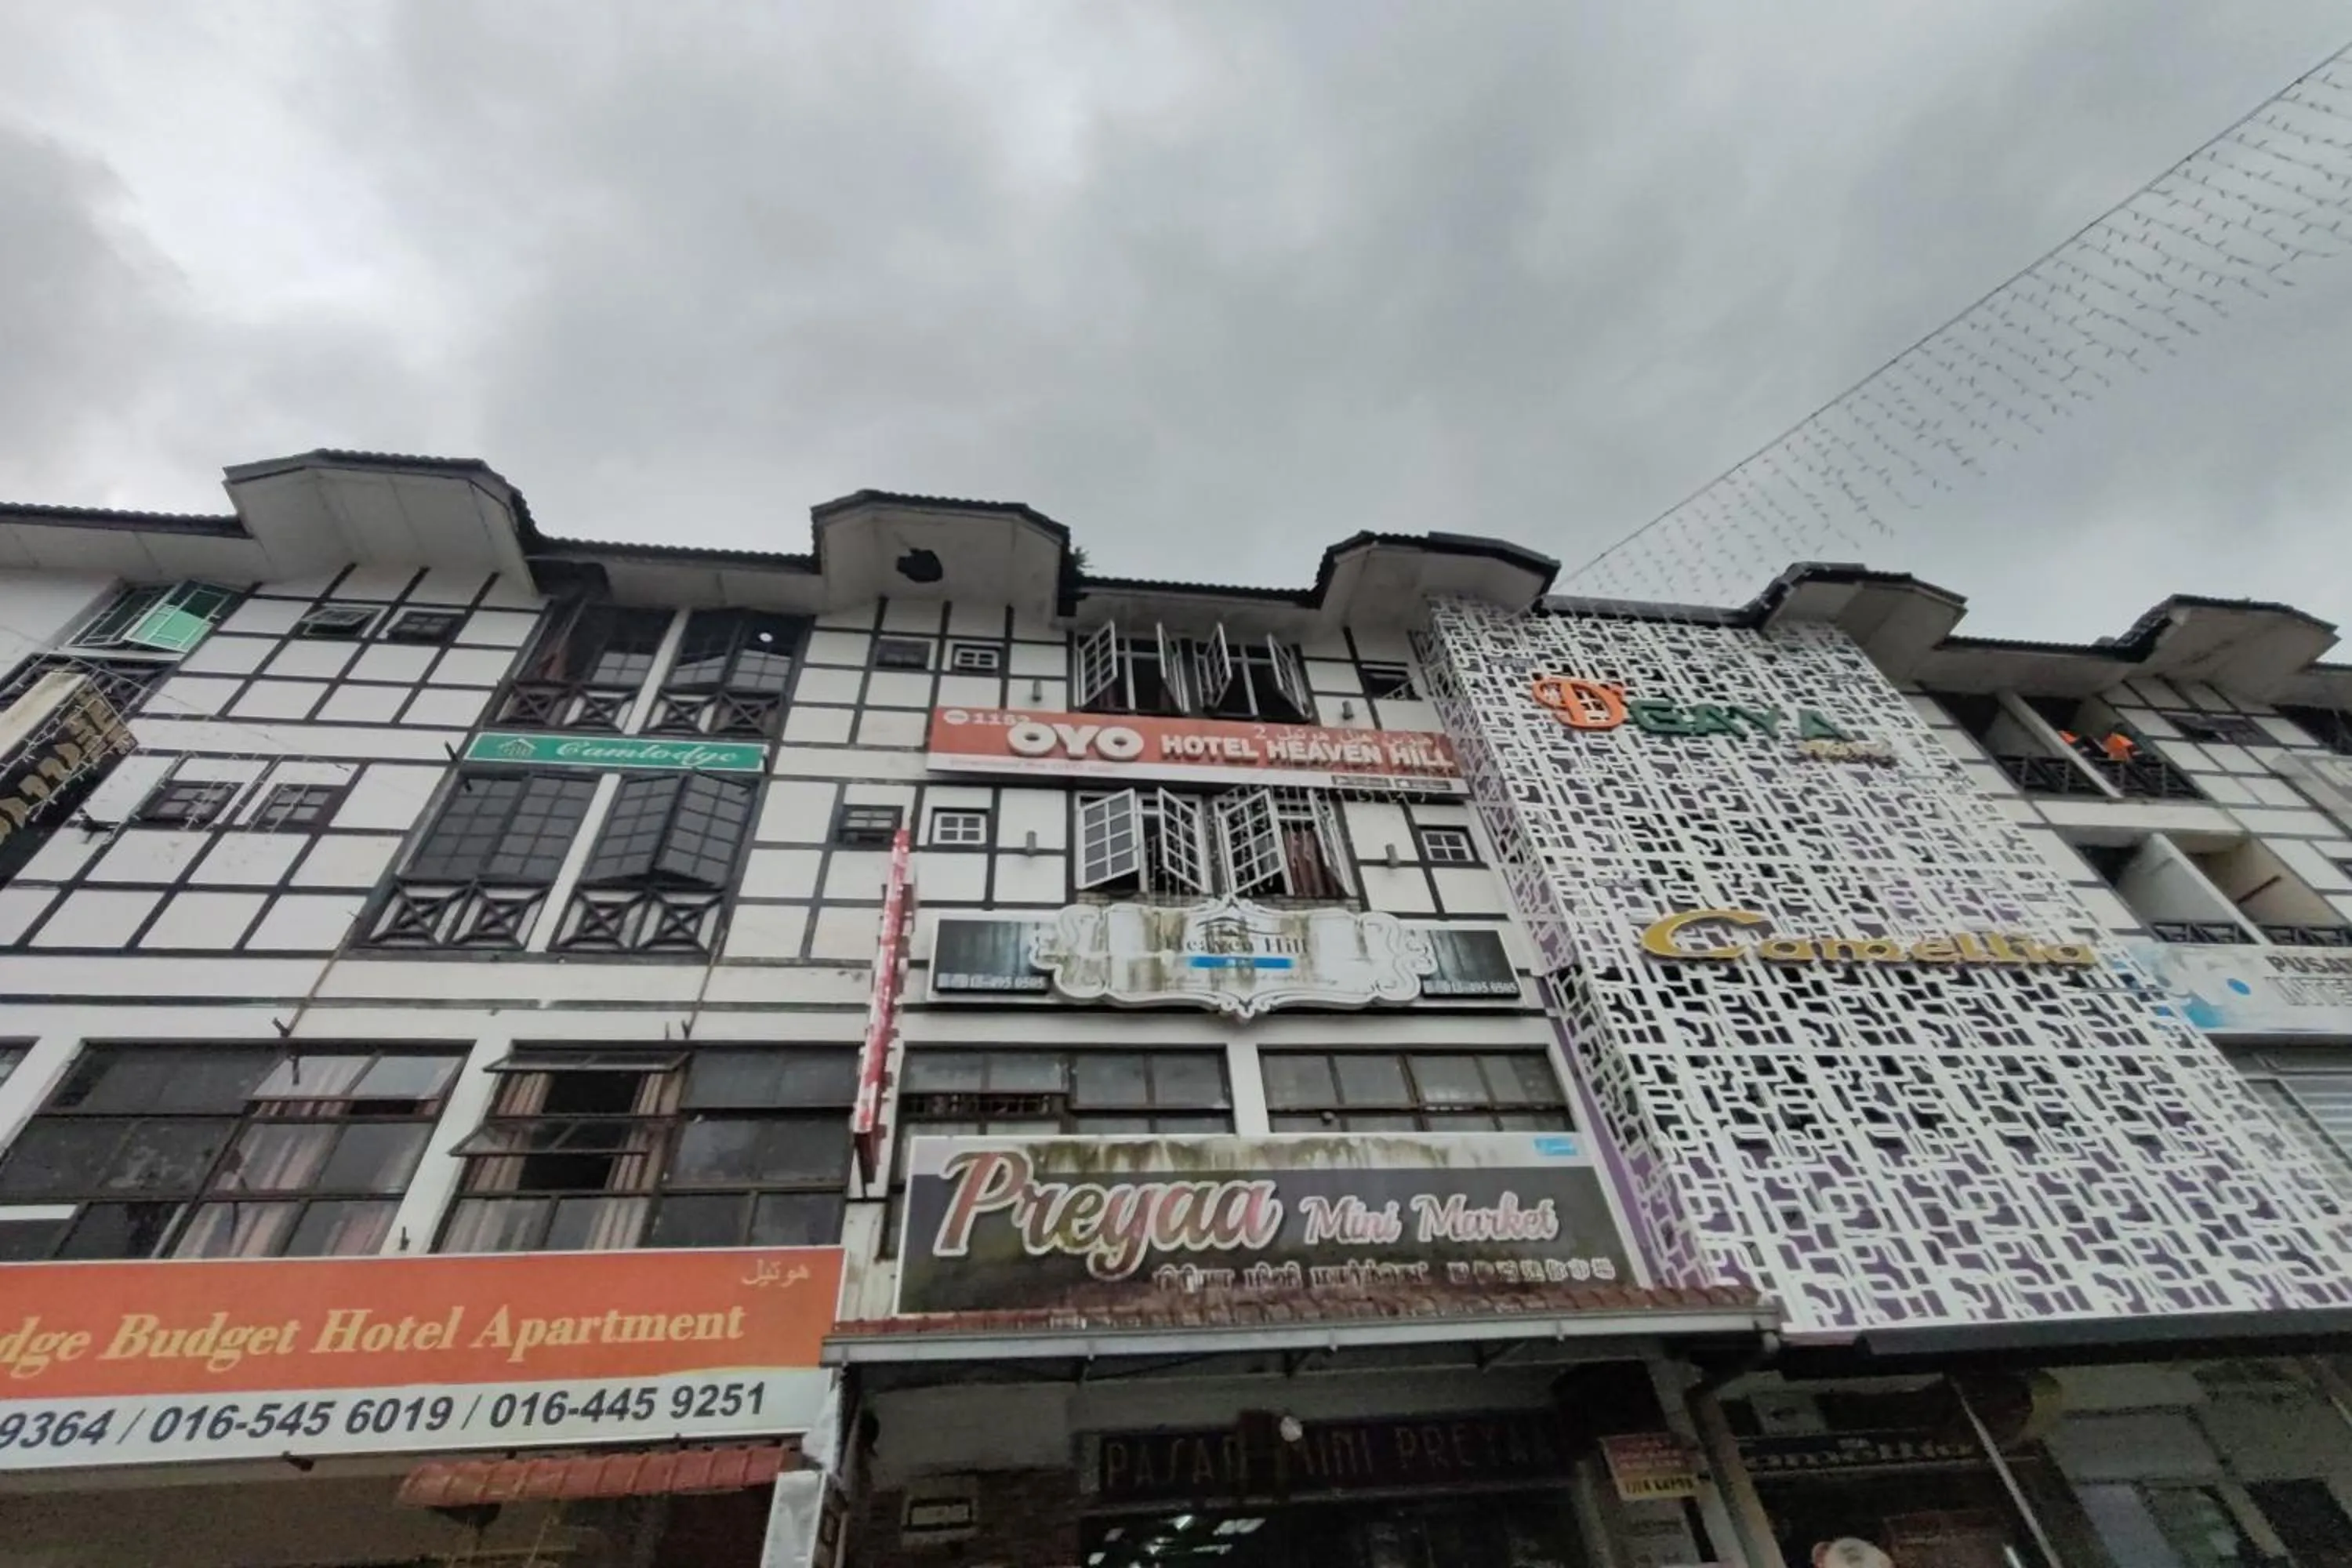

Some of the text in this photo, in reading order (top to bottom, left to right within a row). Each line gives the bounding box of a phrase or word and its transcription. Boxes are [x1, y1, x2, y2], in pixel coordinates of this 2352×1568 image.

[555, 741, 739, 768] Camlodge
[1006, 722, 1145, 762] OYO
[1160, 735, 1259, 760] HOTEL
[1267, 739, 1382, 766] HEAVEN
[1387, 746, 1454, 769] HILL
[932, 1147, 1283, 1282] Preyaa
[1298, 1194, 1403, 1246] Mini
[1410, 1190, 1559, 1243] Market
[96, 1312, 301, 1372] Budget
[310, 1305, 465, 1355] Hotel
[471, 1303, 747, 1363] Apartment
[0, 1408, 115, 1450] 9364
[150, 1400, 336, 1443] 016-545
[345, 1395, 454, 1436] 6019
[489, 1386, 658, 1428] 016-445
[670, 1381, 767, 1420] 9251
